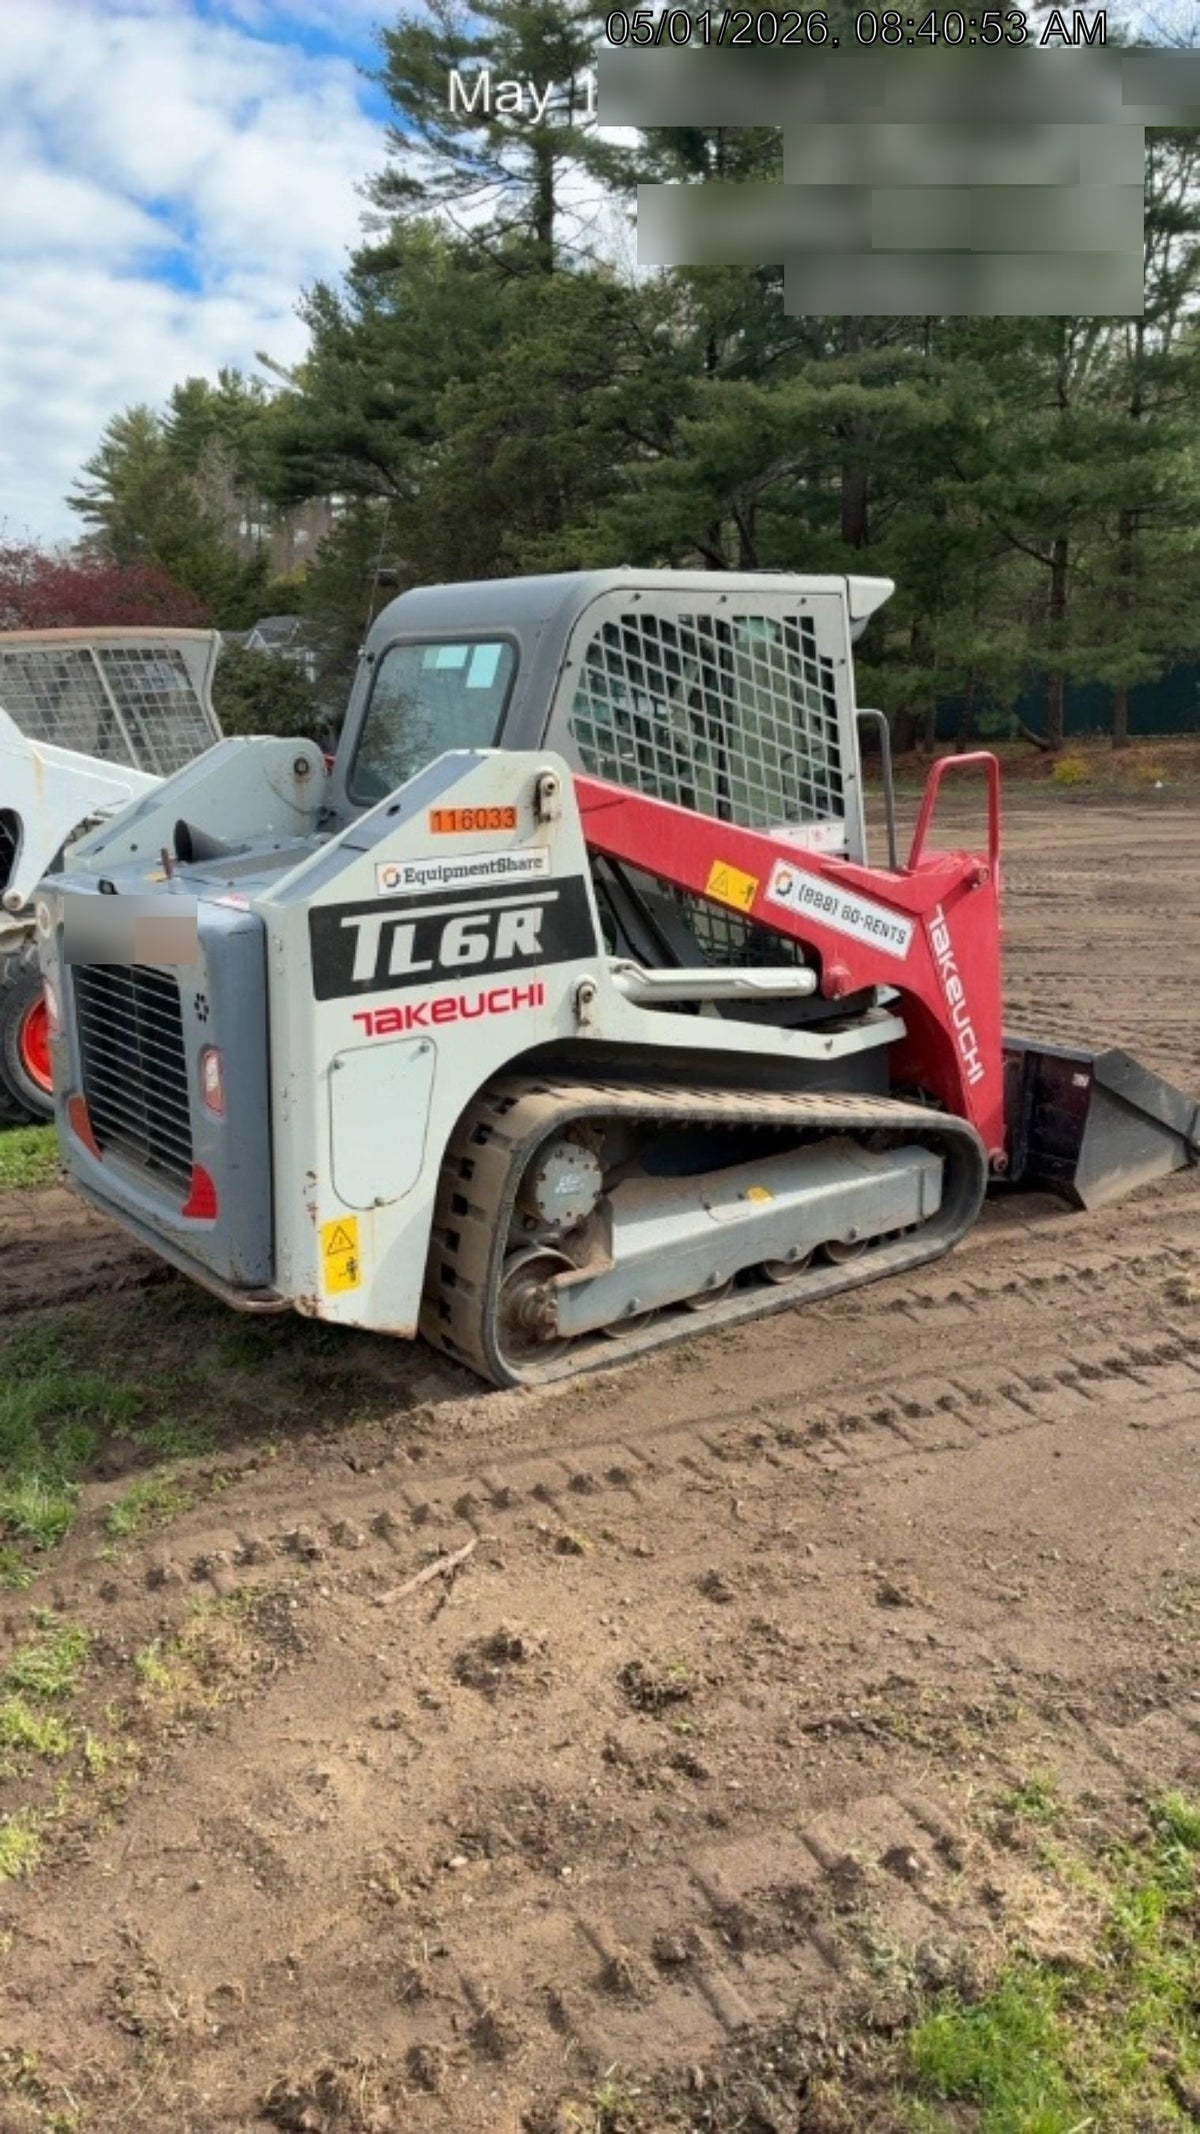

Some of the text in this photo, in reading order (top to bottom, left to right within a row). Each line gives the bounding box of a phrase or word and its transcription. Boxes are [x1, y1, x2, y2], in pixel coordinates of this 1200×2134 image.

[432, 806, 517, 831] 116033
[403, 857, 543, 885] EquipmentShare
[798, 883, 840, 916] (888)
[340, 891, 560, 982] TL6R
